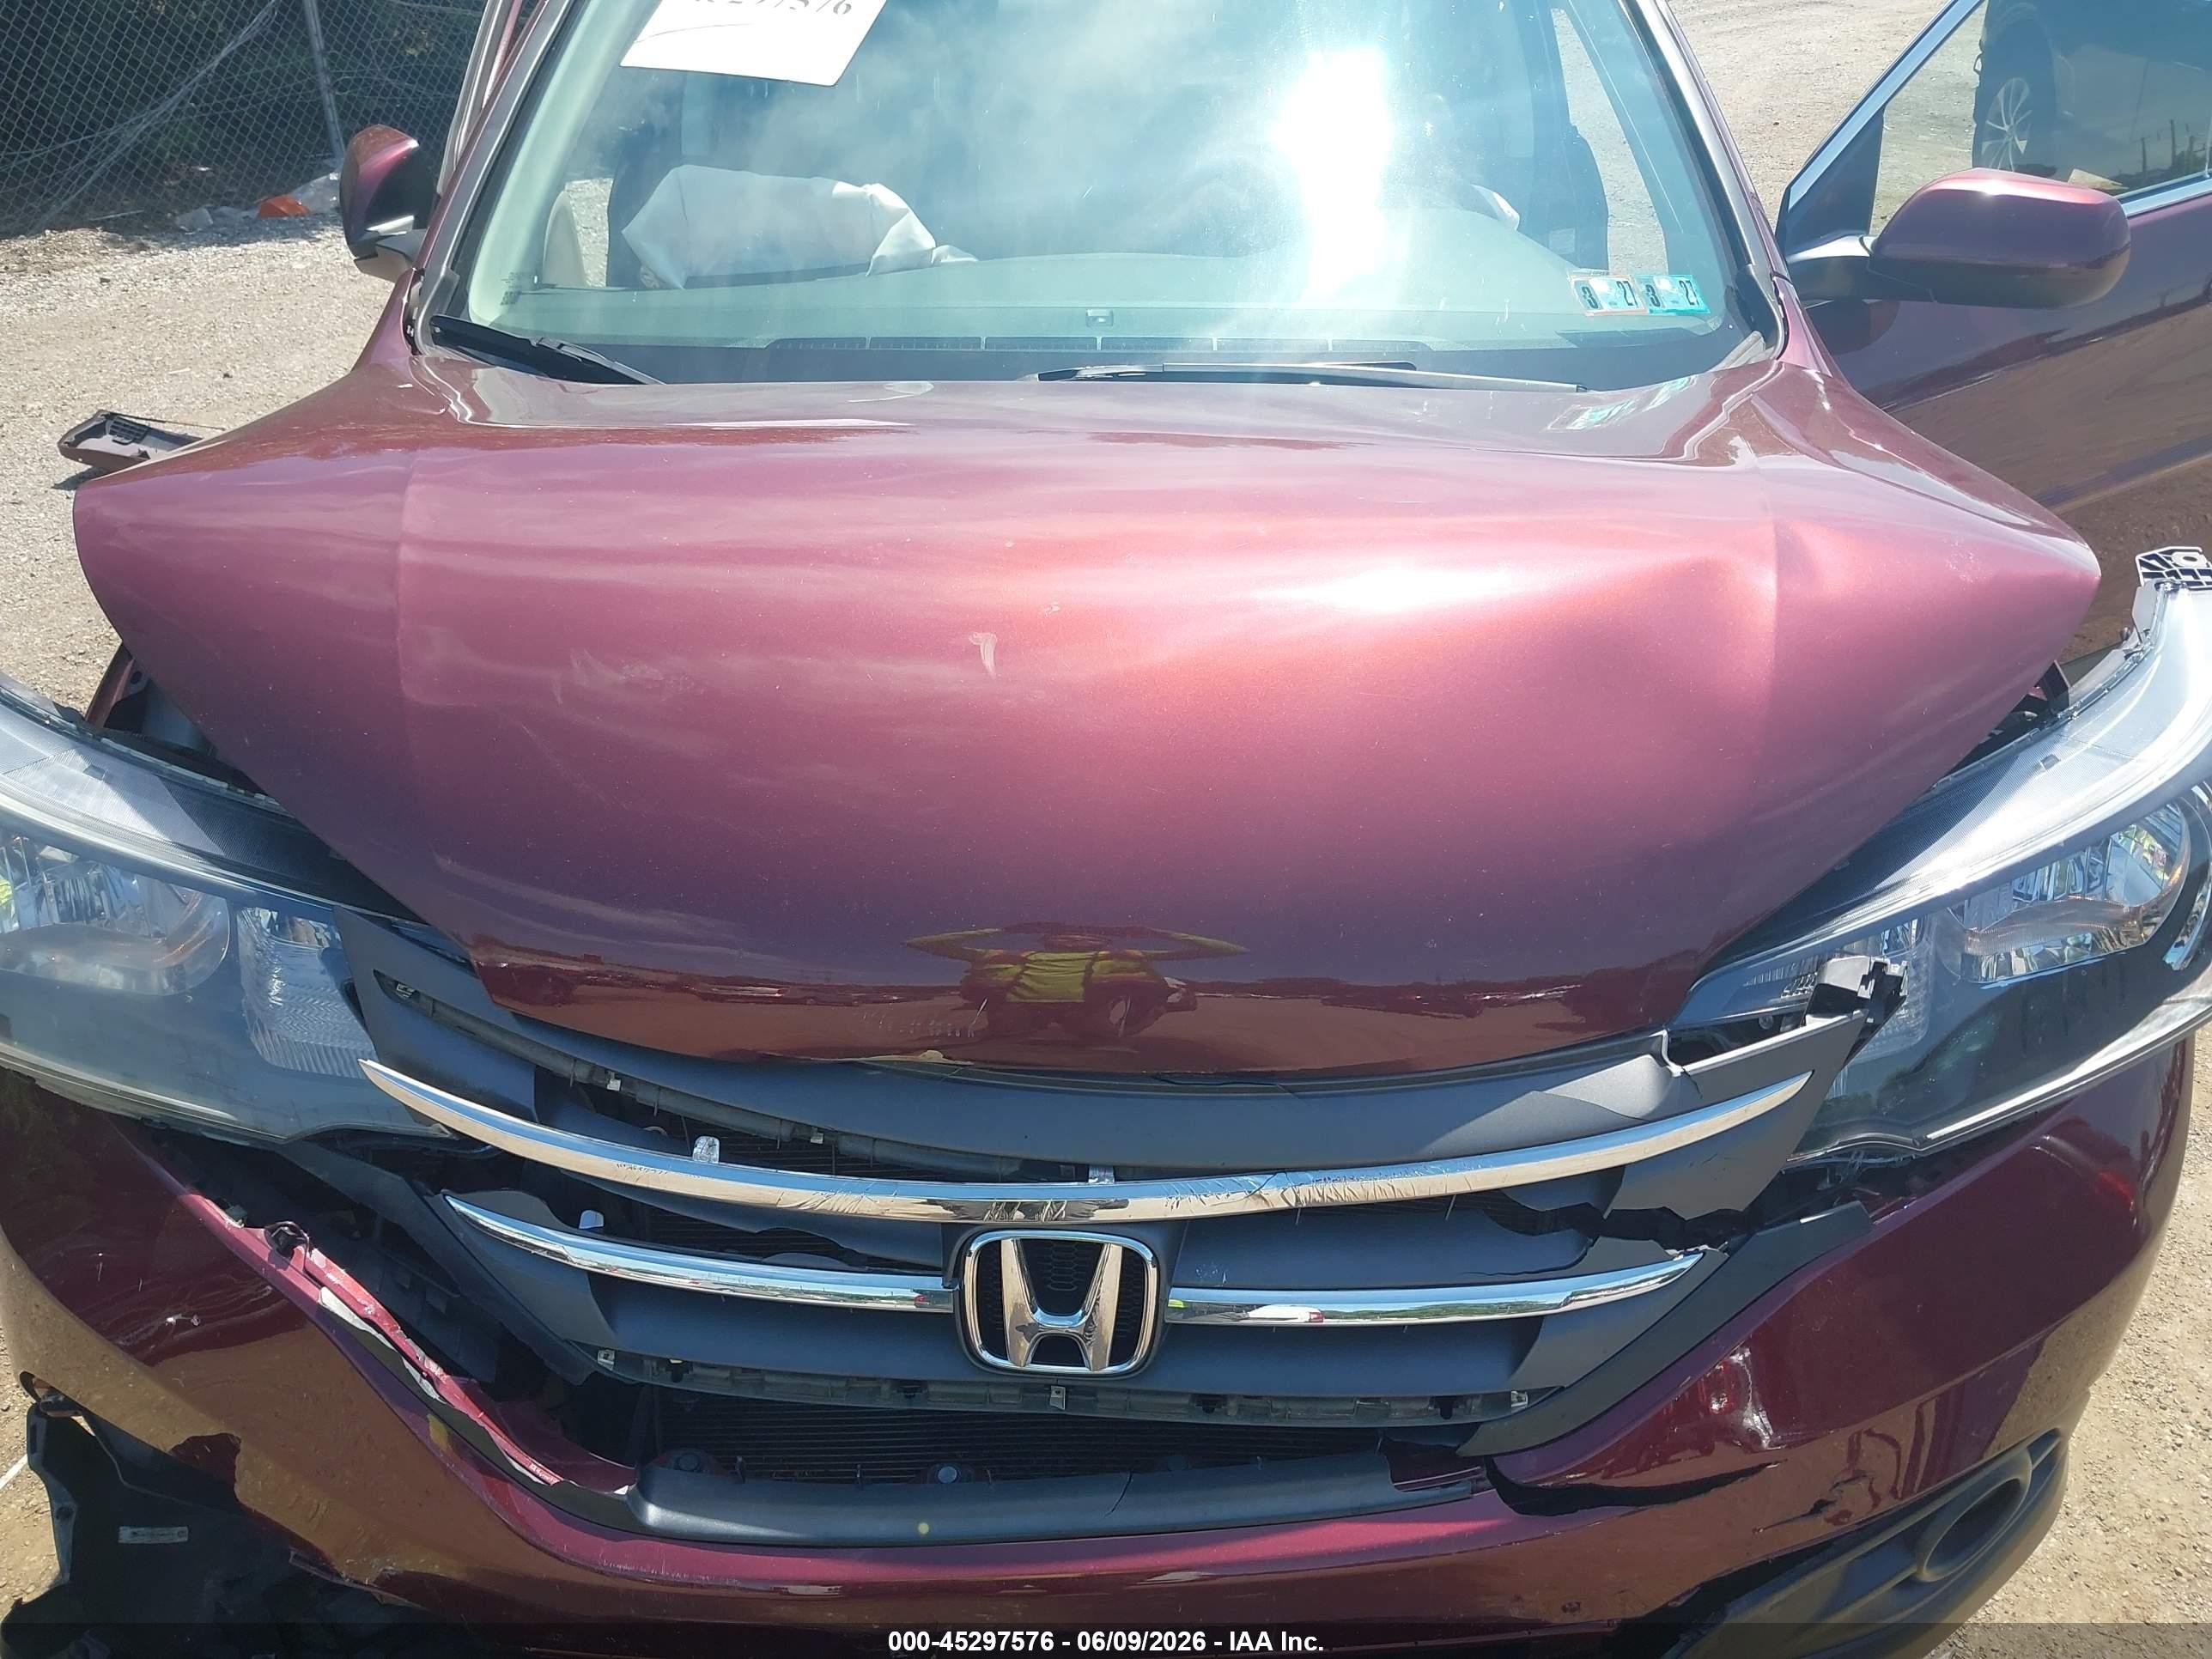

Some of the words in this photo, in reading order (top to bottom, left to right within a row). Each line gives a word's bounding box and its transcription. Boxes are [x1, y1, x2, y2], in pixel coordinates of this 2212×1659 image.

[1581, 286, 1599, 309] 3
[1615, 280, 1639, 307] 27
[1644, 283, 1661, 307] 3
[1678, 279, 1700, 307] 27
